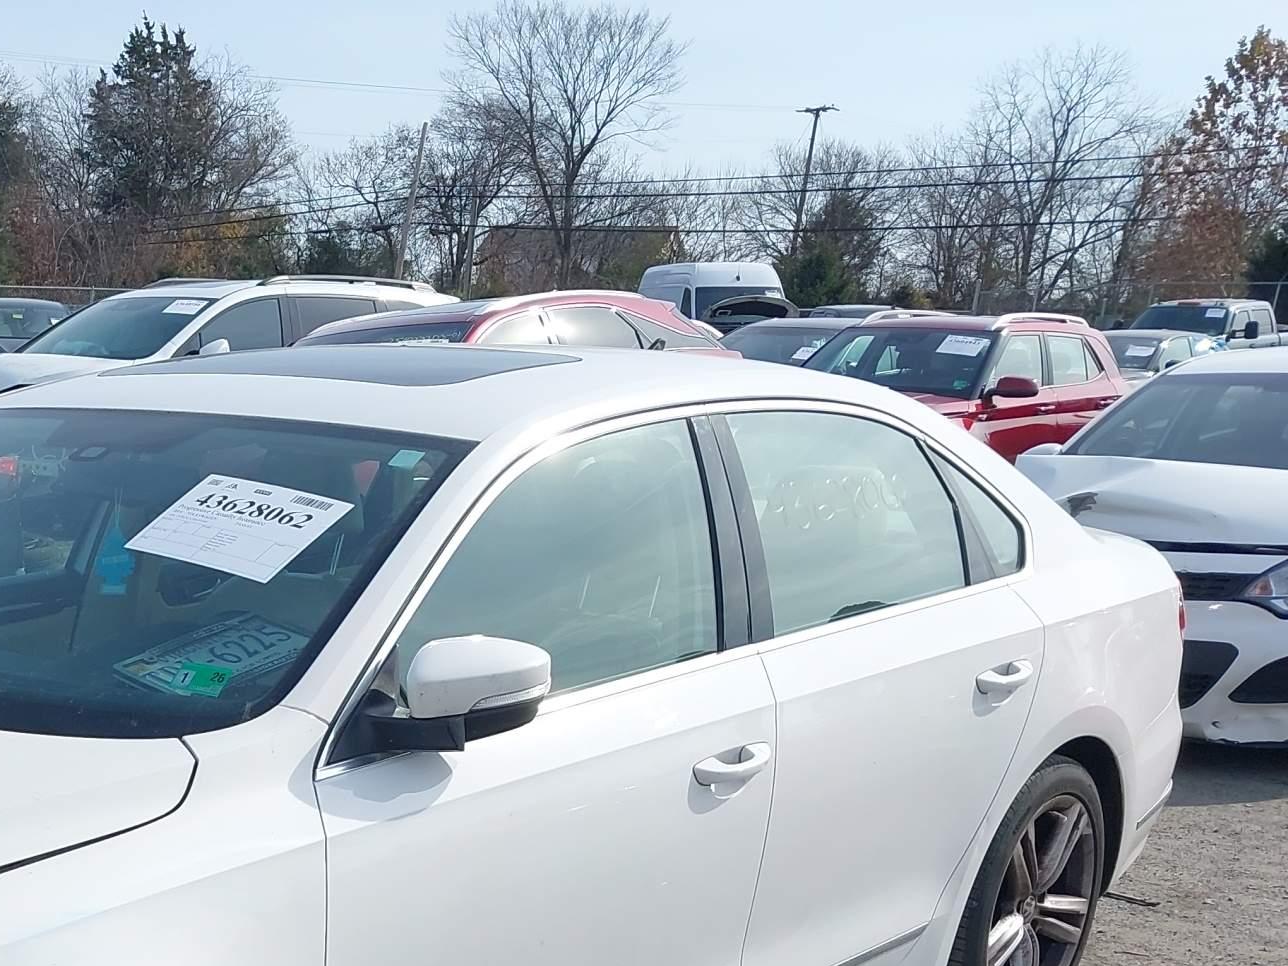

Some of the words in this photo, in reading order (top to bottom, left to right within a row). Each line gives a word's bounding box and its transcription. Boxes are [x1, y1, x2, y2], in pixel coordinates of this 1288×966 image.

[195, 492, 314, 530] 43628062
[180, 671, 190, 684] 1
[209, 671, 226, 684] 26
